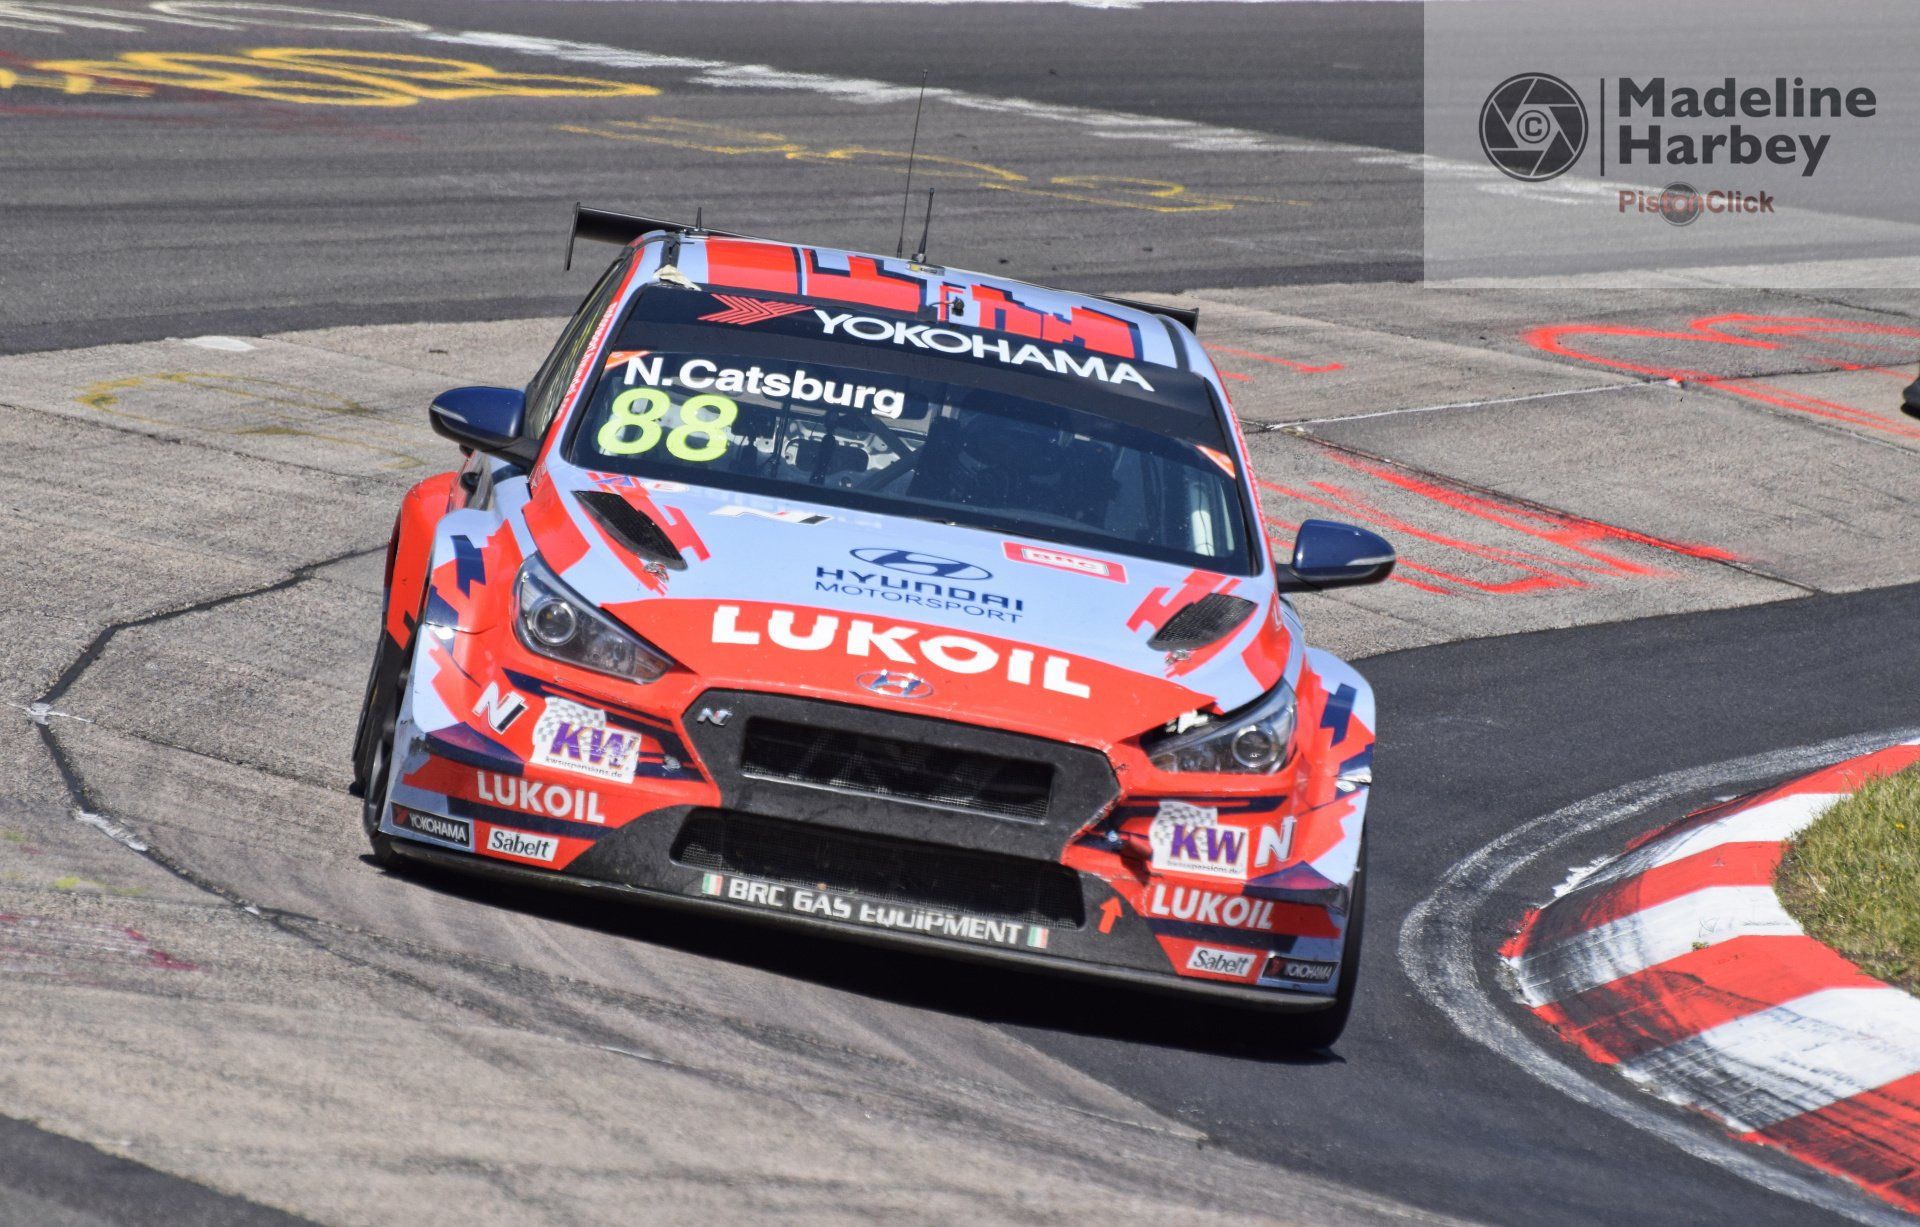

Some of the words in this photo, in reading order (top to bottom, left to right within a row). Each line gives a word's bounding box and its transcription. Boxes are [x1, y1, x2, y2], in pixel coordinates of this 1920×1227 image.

[814, 308, 1155, 392] YOKOHAMA
[597, 387, 739, 462] 88
[814, 581, 1023, 624] MOTORSPORT
[815, 566, 1024, 611] HYUNDAI
[711, 604, 1091, 699] LUKOIL
[549, 721, 638, 771] KW
[476, 771, 606, 824] LUKOIL
[409, 812, 468, 842] YOKOHAMA
[491, 829, 551, 859] Sabelt
[1170, 824, 1247, 866] KW
[728, 877, 786, 908] BRC
[792, 890, 852, 920] GAS
[859, 902, 1022, 945] EQUIPMENT
[1151, 884, 1275, 930] LUKOIL
[1192, 949, 1249, 976] Sabelt
